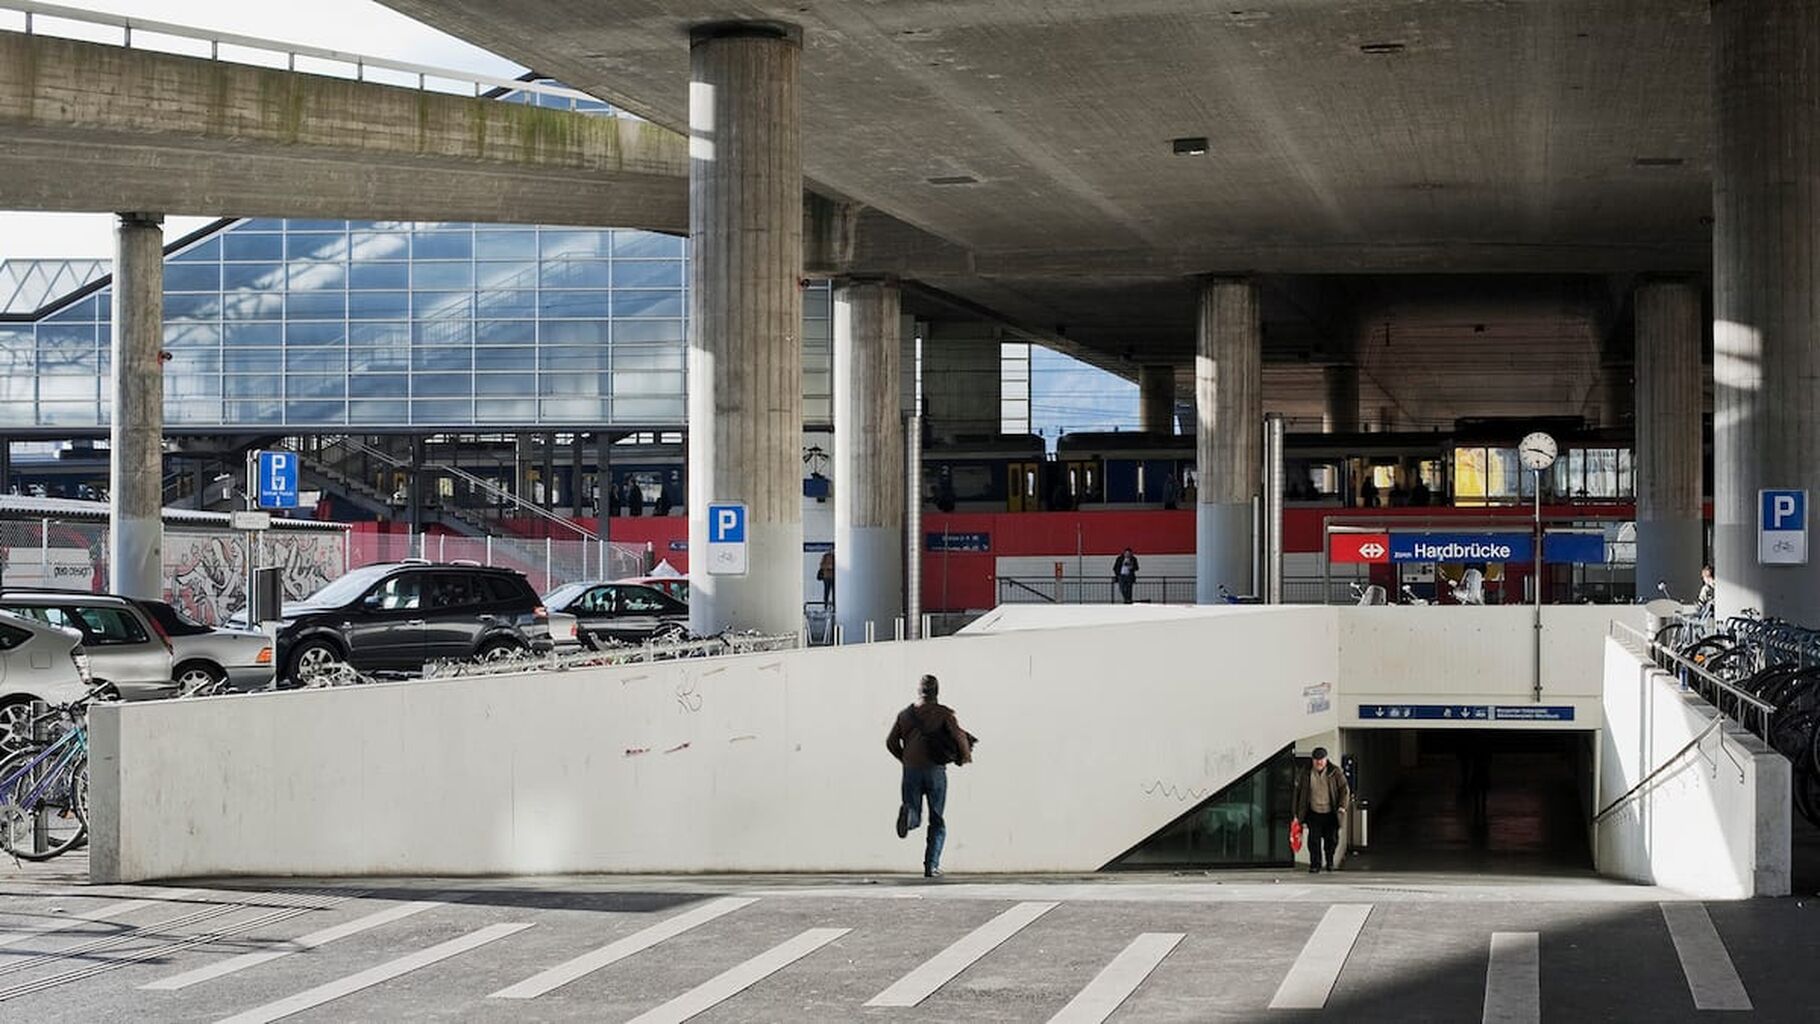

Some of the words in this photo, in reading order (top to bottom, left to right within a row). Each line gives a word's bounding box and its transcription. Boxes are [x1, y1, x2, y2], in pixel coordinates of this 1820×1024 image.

[272, 454, 286, 476] P
[671, 470, 679, 480] 2
[1774, 496, 1795, 528] P
[718, 509, 737, 540] P
[1415, 542, 1511, 560] Hardbrücke
